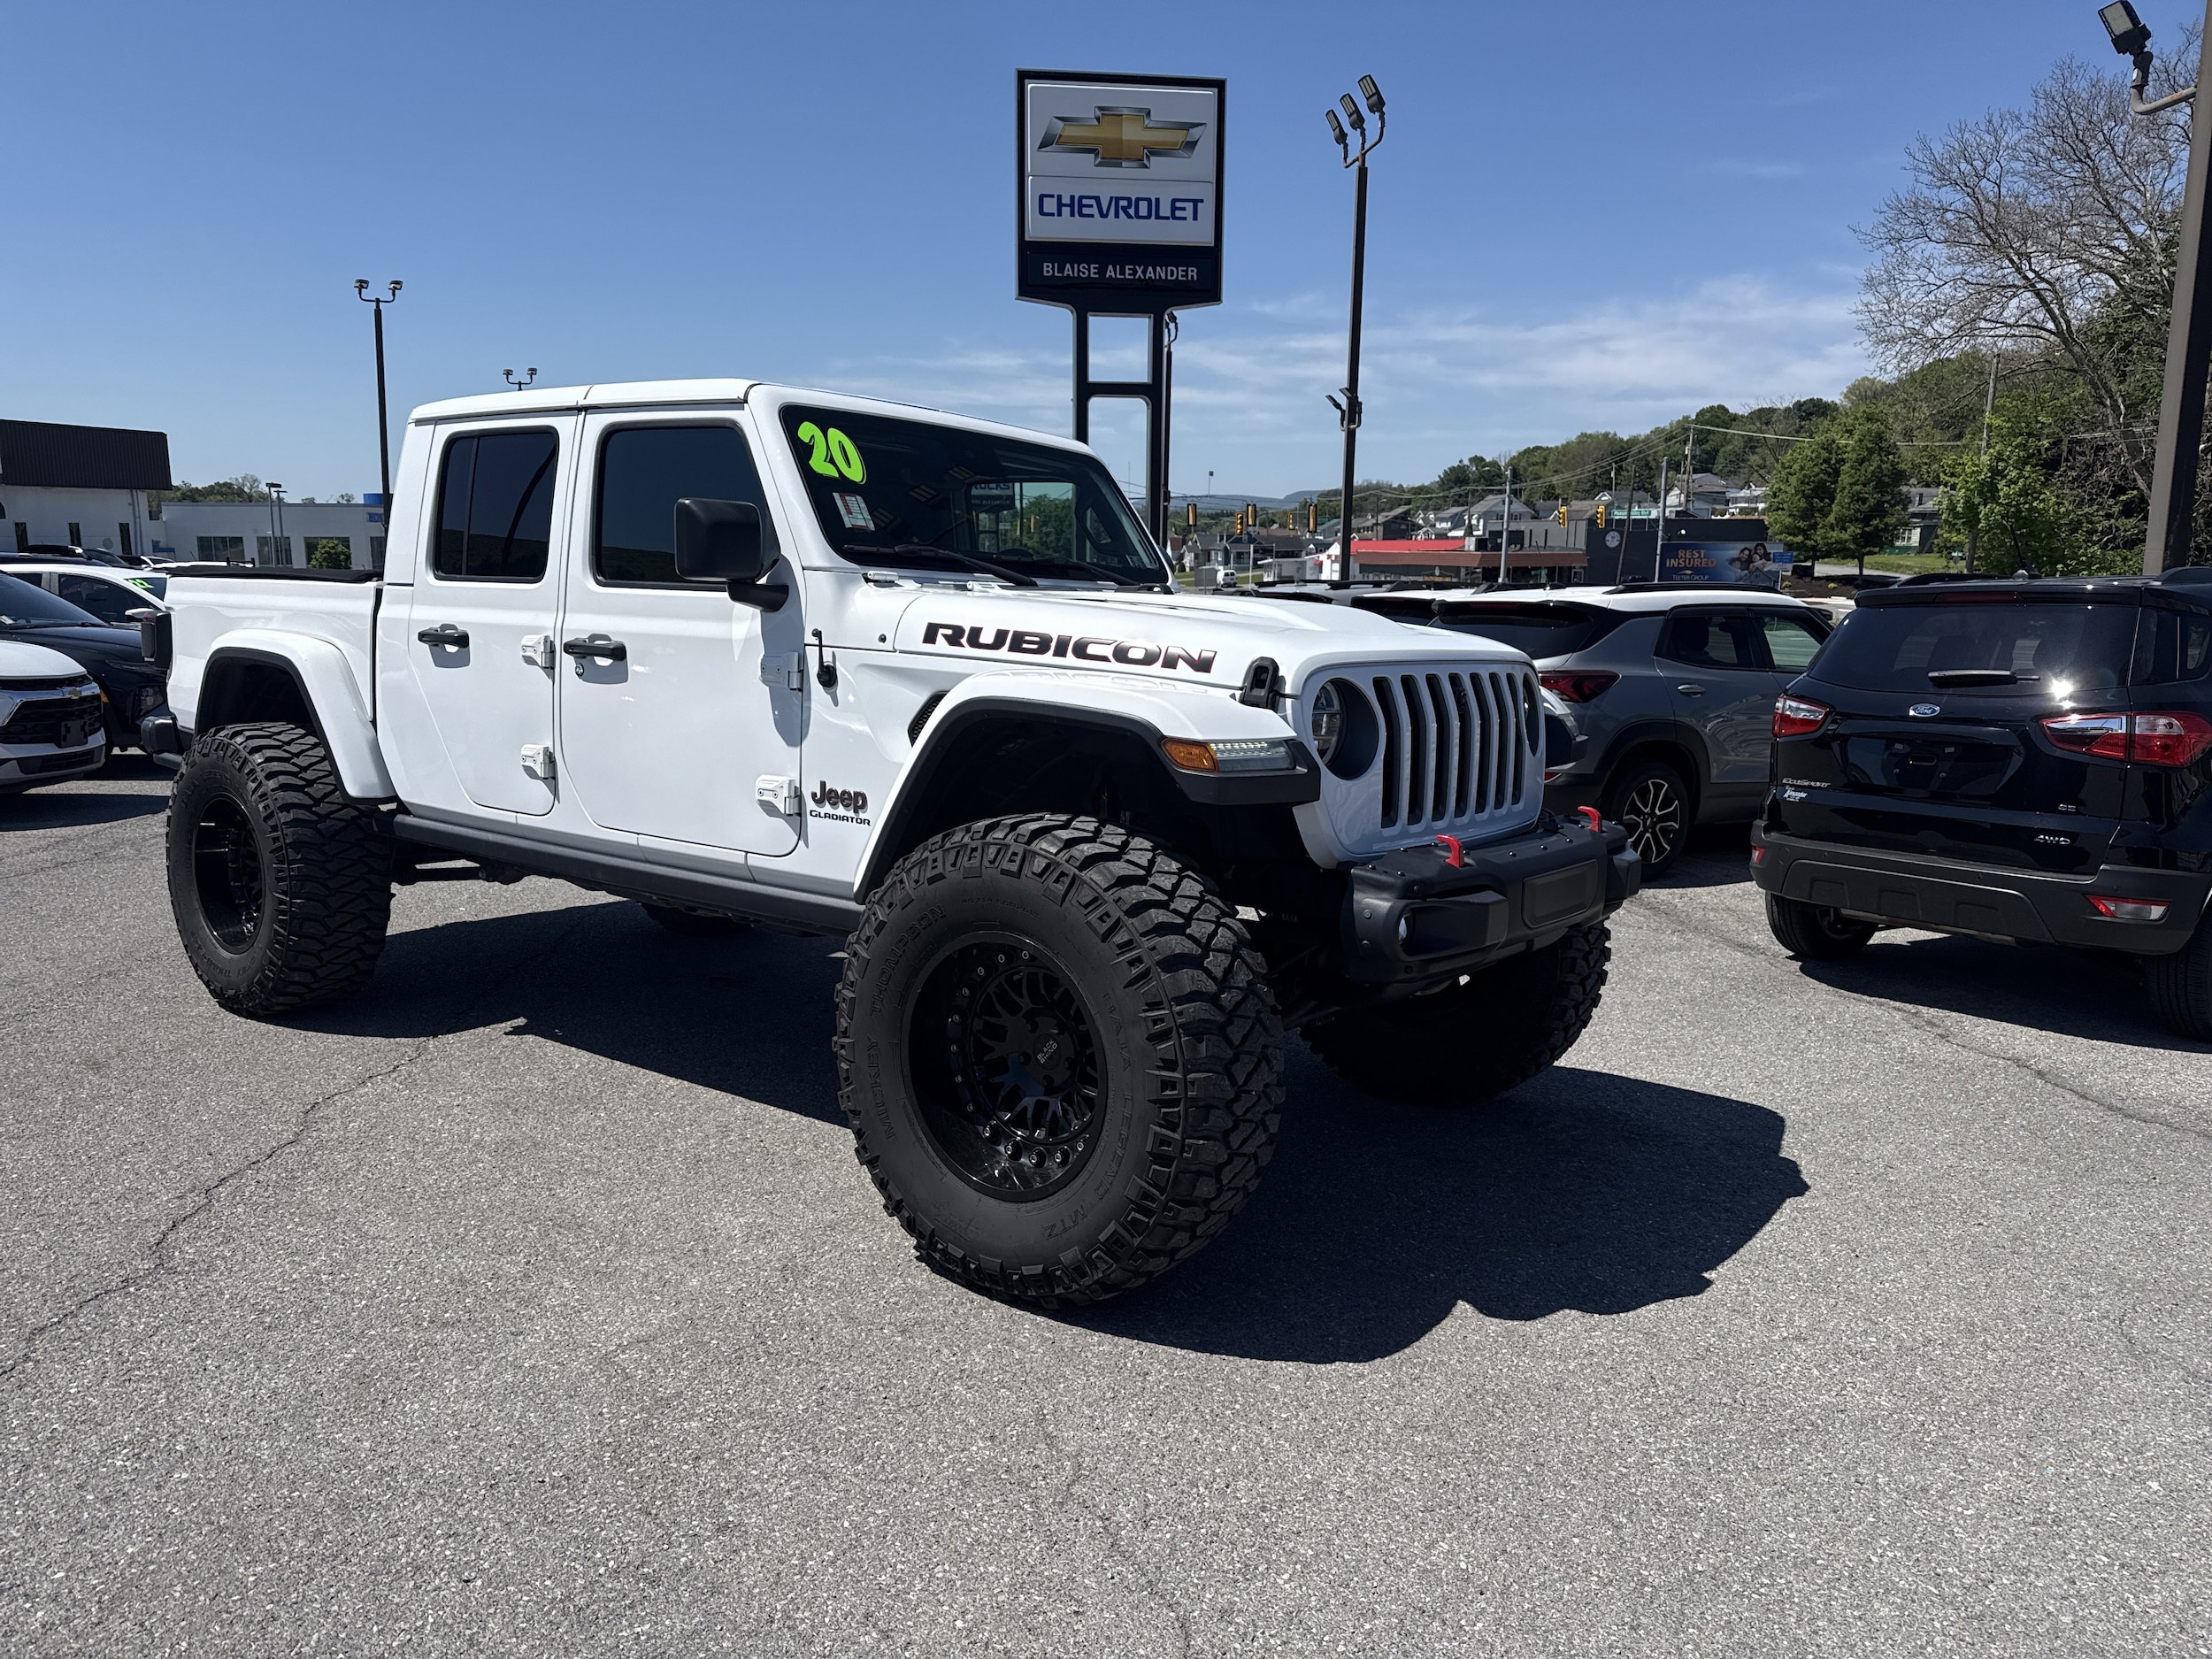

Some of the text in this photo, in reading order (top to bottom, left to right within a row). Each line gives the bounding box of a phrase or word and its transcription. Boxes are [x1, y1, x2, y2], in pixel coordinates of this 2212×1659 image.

[1038, 193, 1204, 221] CHEVROLET
[1042, 262, 1198, 280] BLAISE ALEXANDER
[797, 421, 867, 485] 20
[1665, 558, 1717, 568] INSURED
[1678, 549, 1707, 558] REST
[922, 621, 1218, 674] RUBICON
[810, 780, 868, 814] Jeep
[809, 809, 872, 826] GLADIATOR
[2034, 834, 2071, 844] 4WD
[866, 903, 948, 1141] MICKEY THOMPSON
[1036, 1038, 1055, 1060] BLACK
[1040, 1042, 1058, 1064] RHINO
[1094, 1091, 1133, 1201] LEGEND
